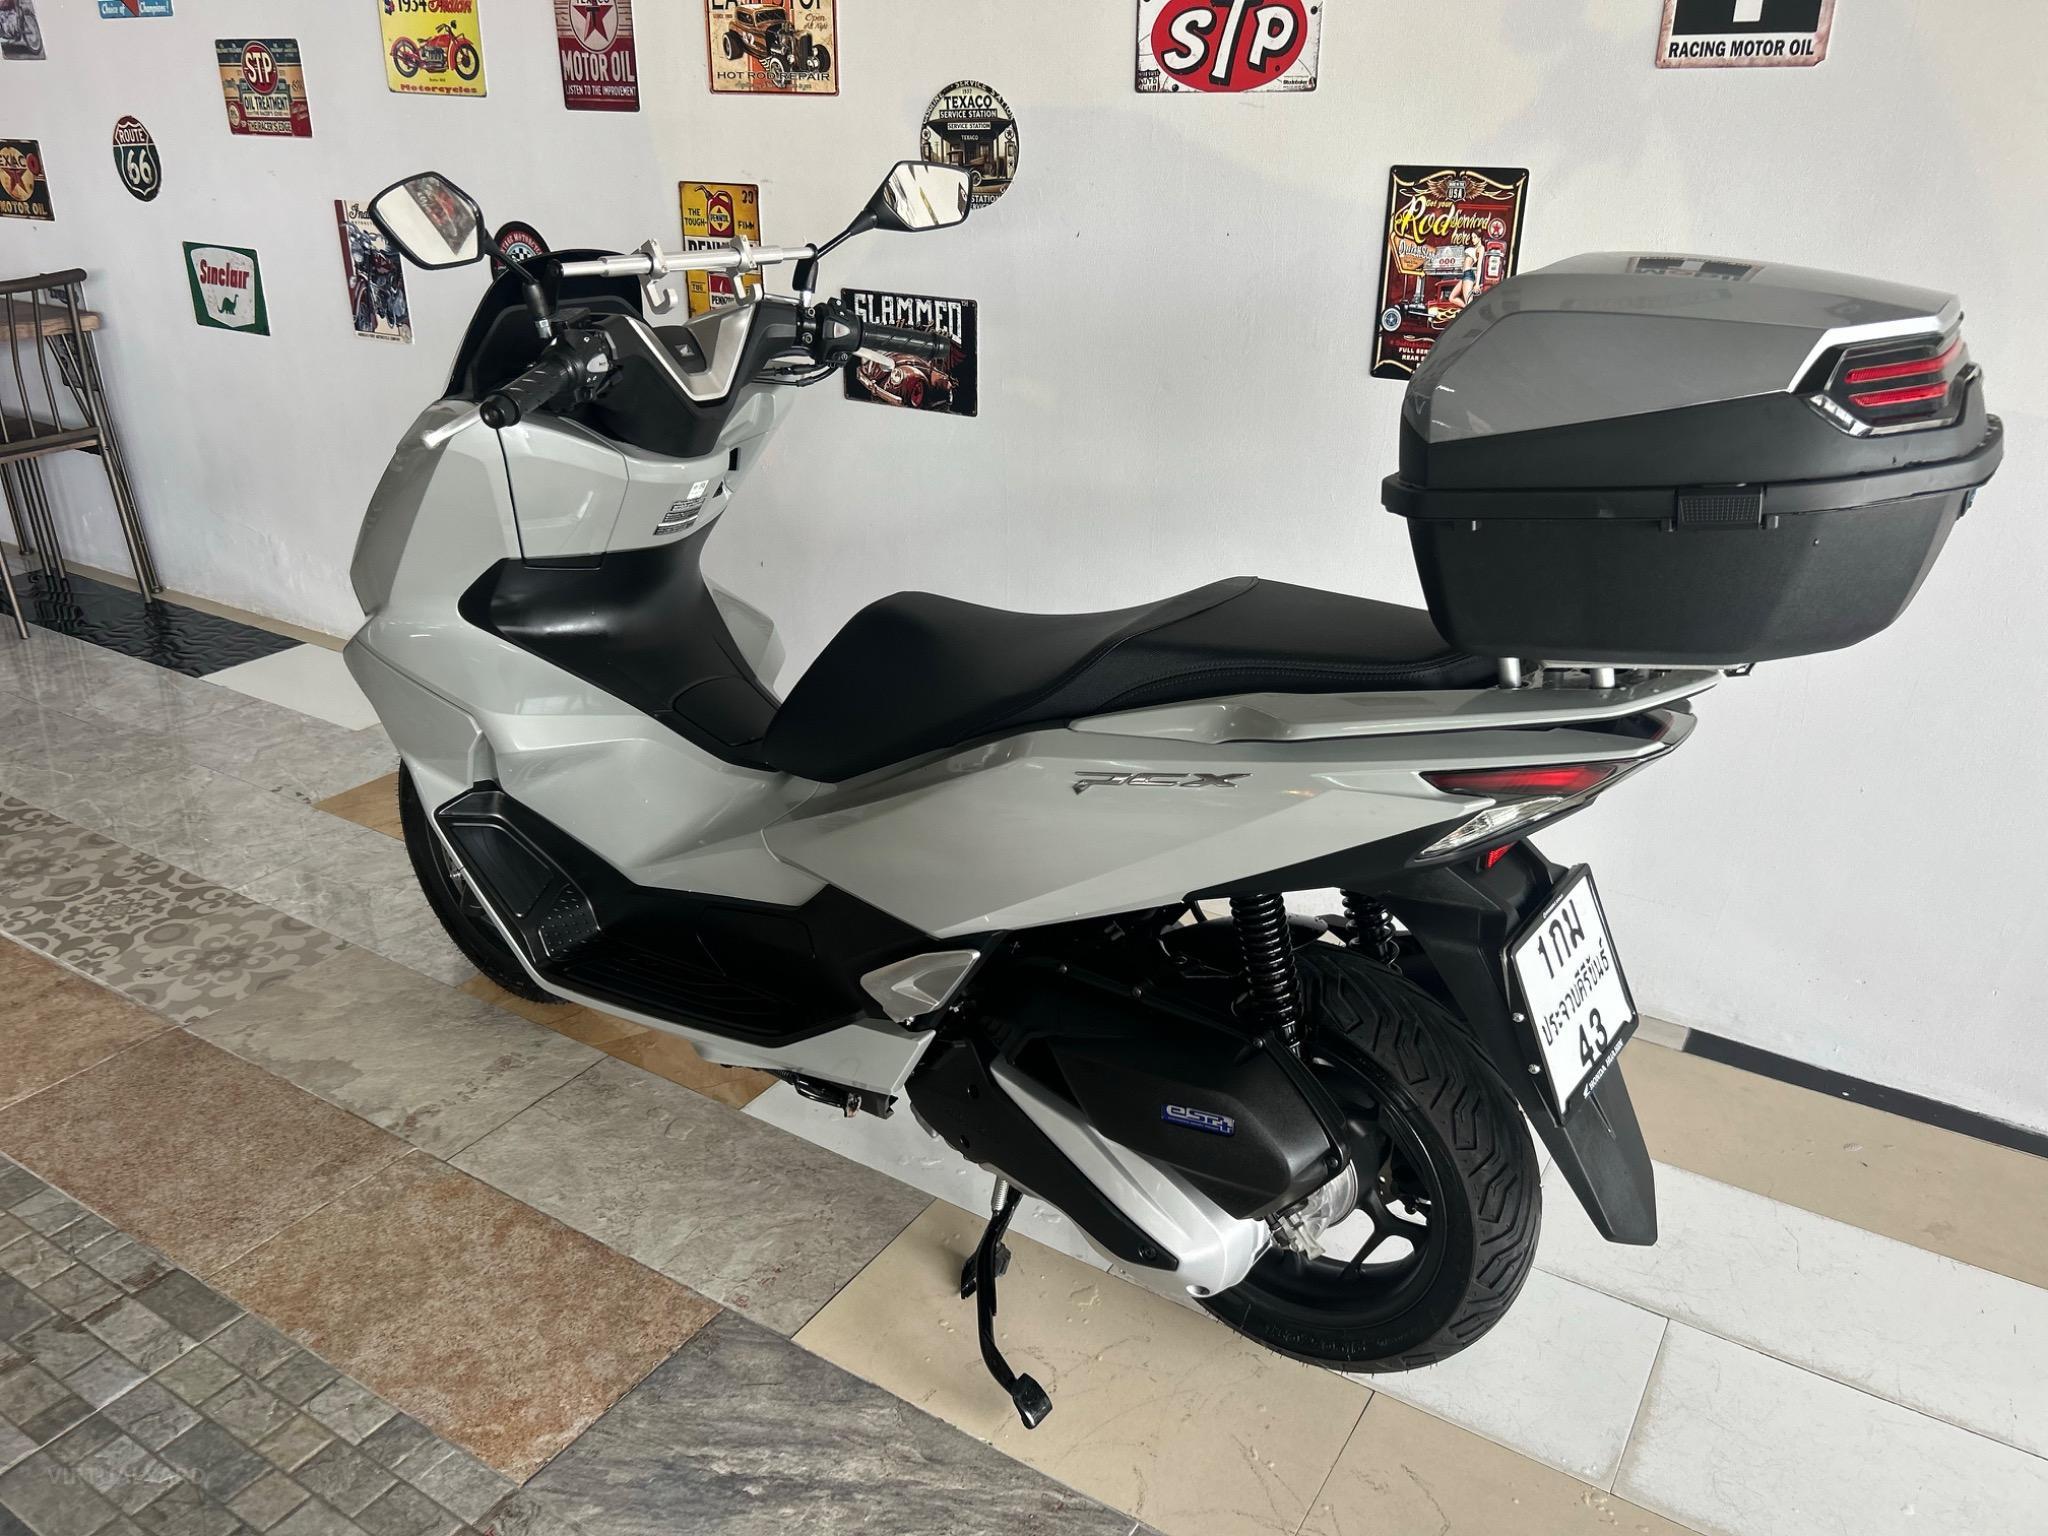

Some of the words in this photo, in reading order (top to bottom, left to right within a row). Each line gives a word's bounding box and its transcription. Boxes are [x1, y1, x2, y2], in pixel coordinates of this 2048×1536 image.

[1161, 0, 1298, 86] STP
[1668, 41, 1727, 58] RACING
[1729, 40, 1786, 58] MOTOR
[1789, 39, 1815, 56] OIL
[246, 52, 272, 83] STP
[561, 50, 610, 82] MOTOR
[610, 51, 636, 82] OIL
[717, 72, 744, 80] HOT
[747, 72, 776, 80] ROD
[779, 72, 830, 81] REPAIR
[400, 83, 478, 94] Motorcycles
[565, 85, 584, 95] LISTEN
[584, 85, 591, 95] TO
[244, 96, 255, 110] OIL
[255, 96, 289, 110] TREATMENT
[944, 95, 993, 110] TEXACO
[940, 111, 967, 119] SERVICE
[968, 110, 997, 118] STATION
[119, 128, 145, 143] ROUTE
[127, 149, 153, 185] 66
[1448, 188, 1463, 199] USA
[0, 200, 31, 215] MOTOR
[32, 202, 48, 216] OIL
[687, 208, 701, 217] THE
[1394, 195, 1456, 244] Rod
[1450, 208, 1492, 231] Serviced
[1451, 229, 1473, 246] here
[200, 258, 250, 290] Sinclair
[853, 293, 962, 345] SLAMMED
[1537, 898, 1586, 980] 1กม
[1579, 1007, 1609, 1068] 43
[1588, 1064, 1607, 1091] HONDA
